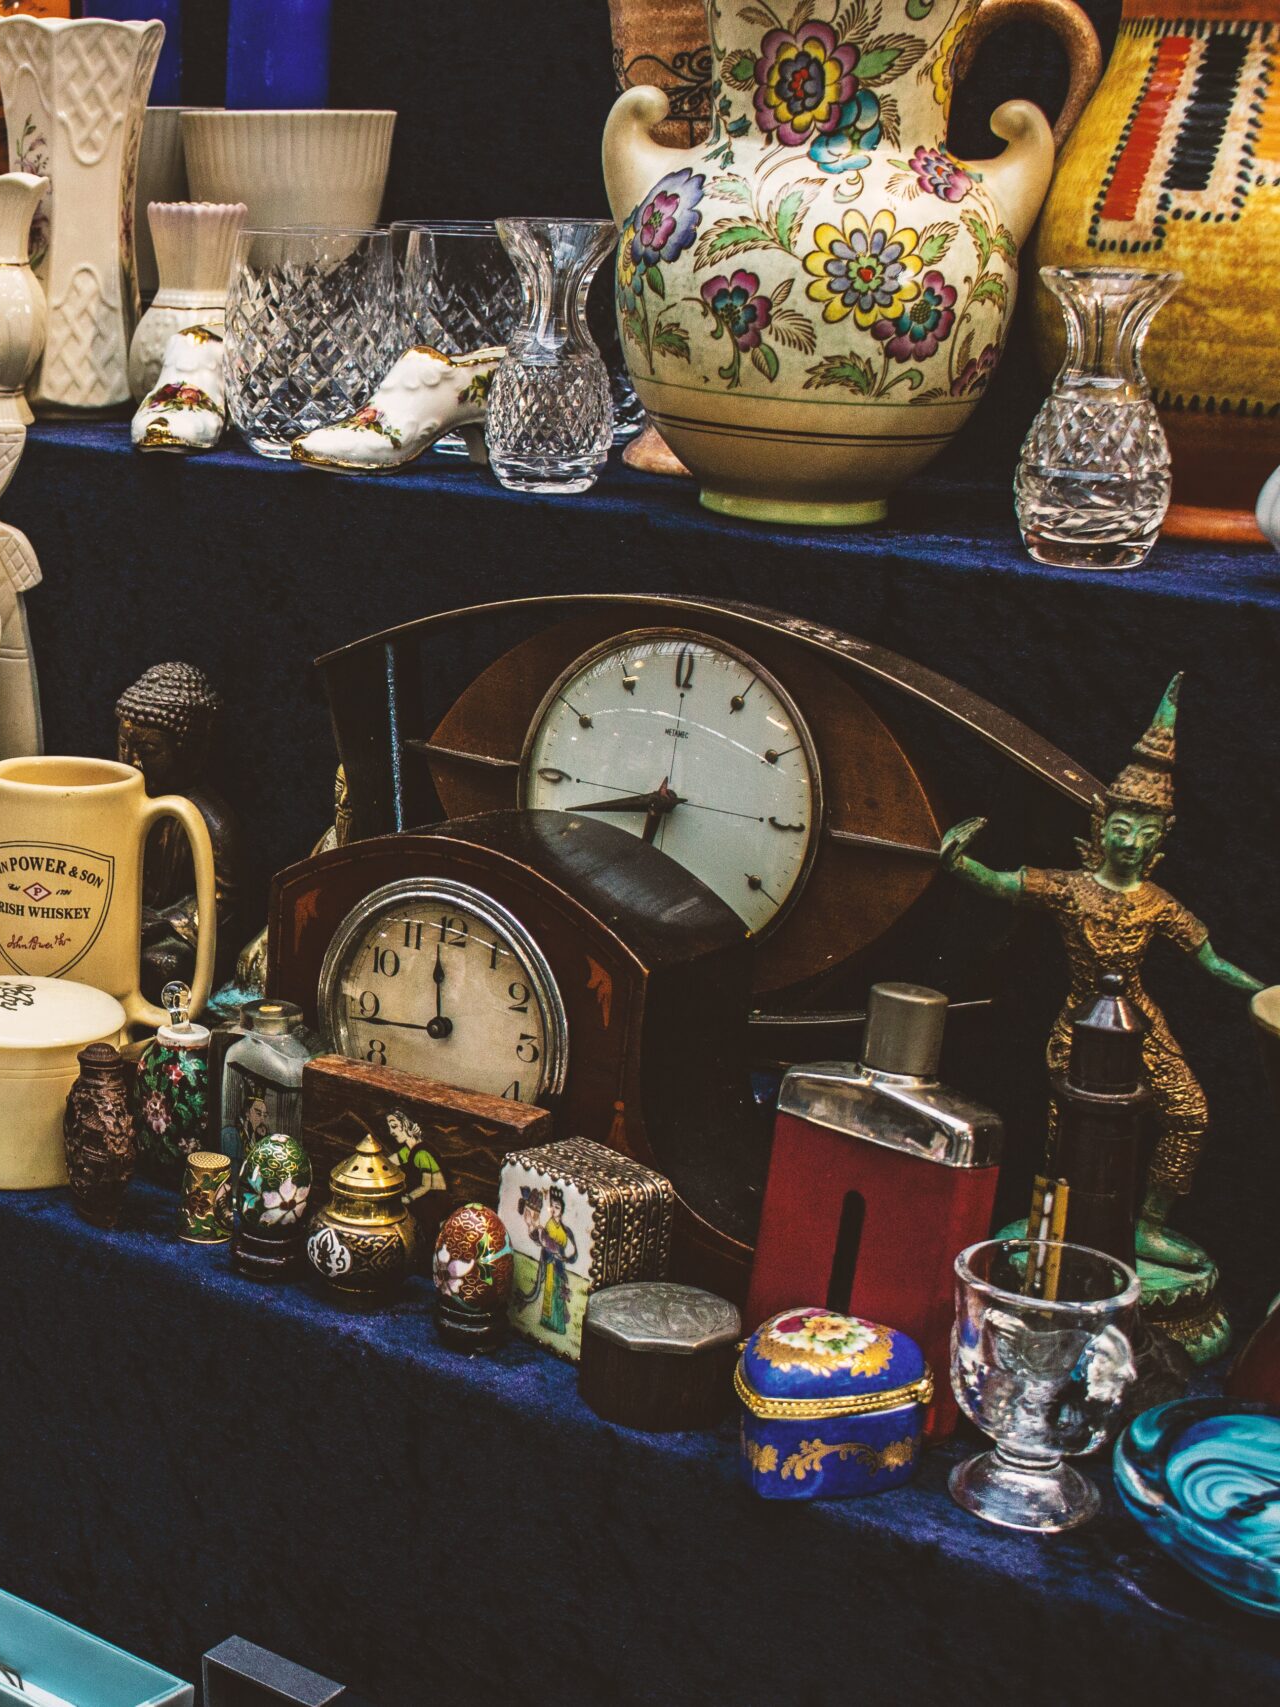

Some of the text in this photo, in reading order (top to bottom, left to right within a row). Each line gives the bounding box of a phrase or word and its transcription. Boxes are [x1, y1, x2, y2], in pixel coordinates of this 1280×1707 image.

[675, 642, 694, 690] 12
[9, 856, 67, 875] POWER
[68, 866, 78, 879] &
[79, 869, 104, 889] SON
[33, 887, 42, 897] P
[28, 905, 91, 919] WHISKEY
[403, 920, 422, 950] 11
[438, 915, 468, 948] 12
[372, 946, 400, 977] 10
[488, 941, 498, 970] 1
[359, 990, 380, 1018] 9
[508, 982, 531, 1013] 2
[366, 1039, 387, 1066] 8
[516, 1033, 539, 1063] 3
[501, 1080, 523, 1102] 4
